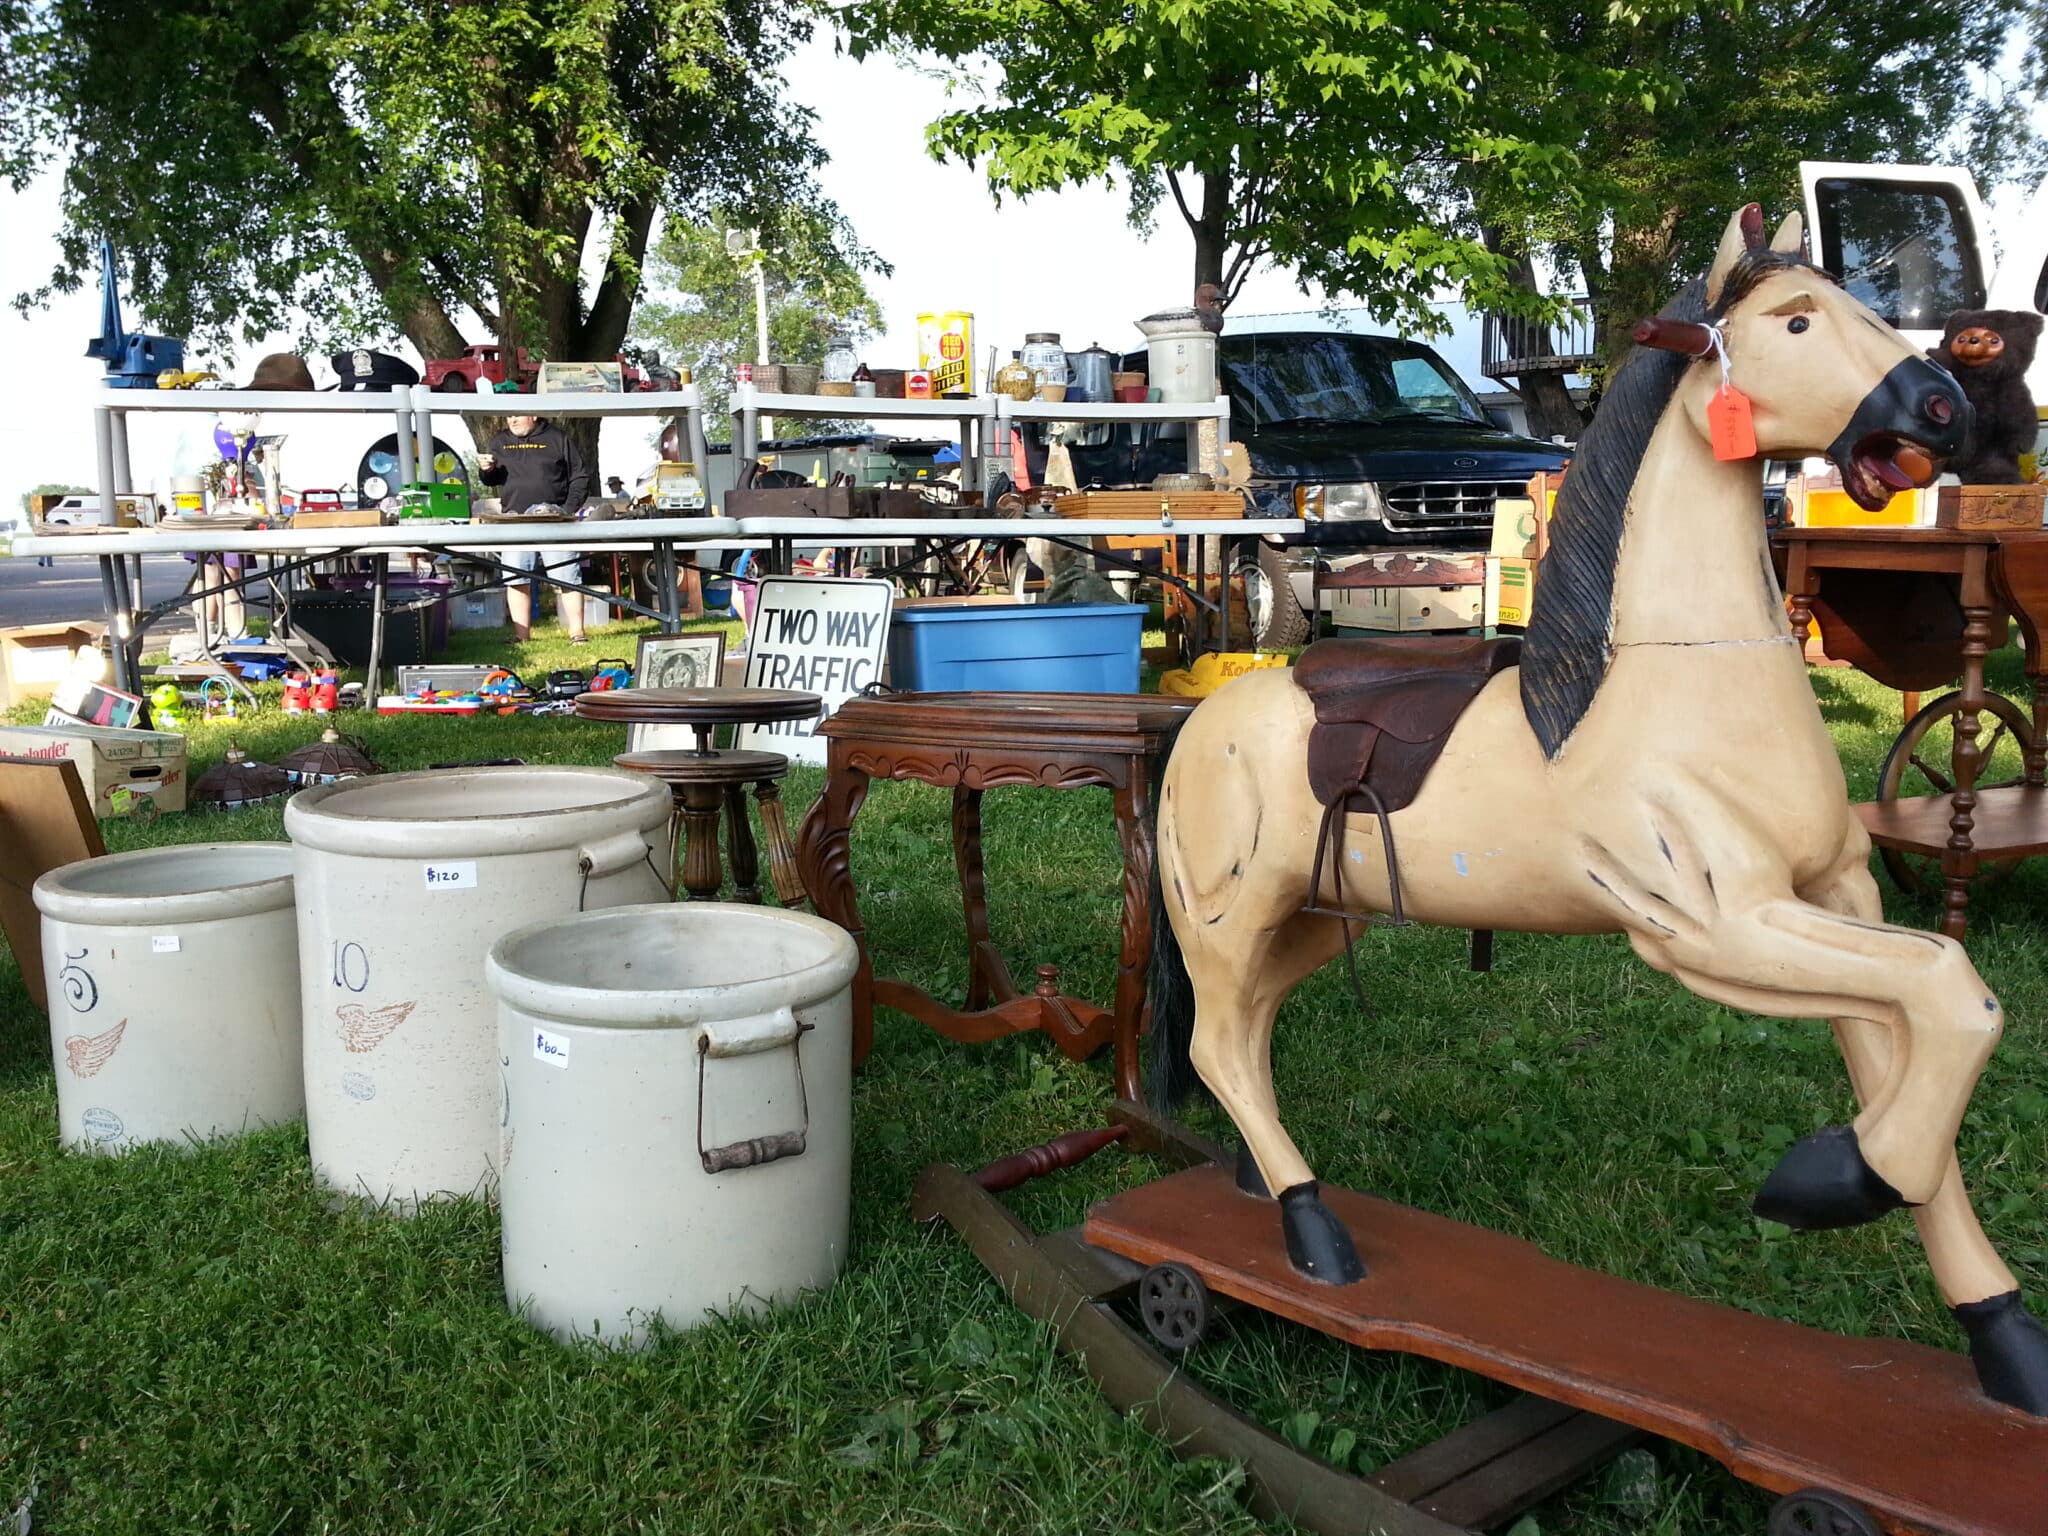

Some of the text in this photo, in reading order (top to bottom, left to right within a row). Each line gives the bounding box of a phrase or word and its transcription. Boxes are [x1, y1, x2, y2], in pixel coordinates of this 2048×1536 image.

[943, 335, 961, 346] RED
[934, 374, 961, 392] HIPS
[764, 608, 881, 648] TWO WAY
[756, 653, 872, 694] TRAFFIC
[1219, 661, 1273, 677] Kod
[427, 867, 460, 883] $120
[60, 948, 98, 1013] 5
[332, 939, 370, 993] 10
